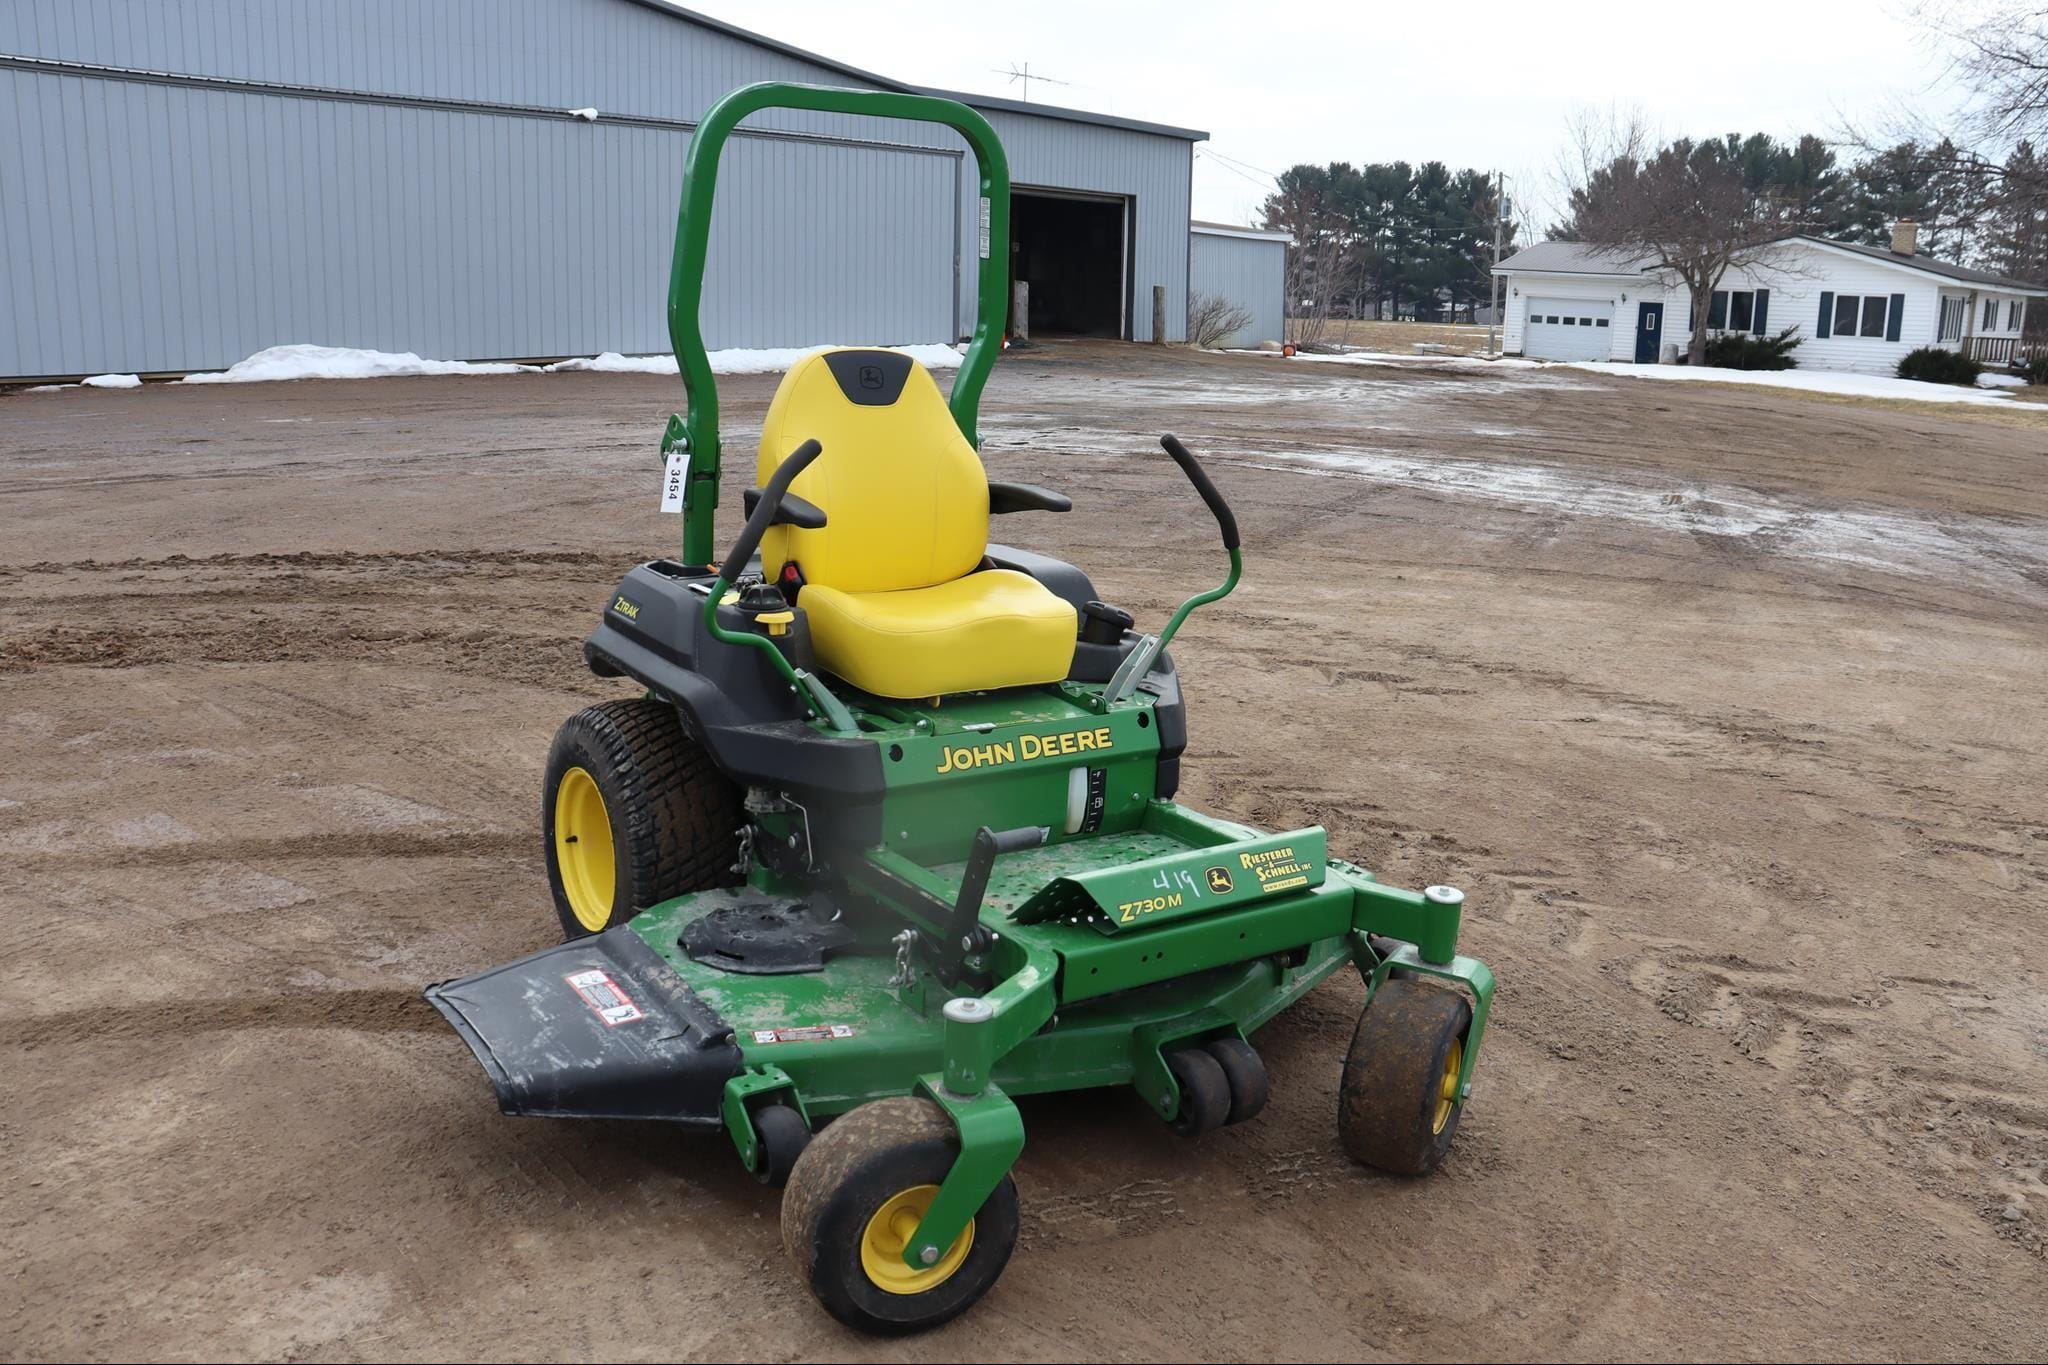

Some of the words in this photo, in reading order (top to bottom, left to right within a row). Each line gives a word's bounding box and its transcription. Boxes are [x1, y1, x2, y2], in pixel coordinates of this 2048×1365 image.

[668, 469, 681, 500] 3454
[613, 596, 640, 619] ZTRAK
[936, 741, 1015, 774] JOHN
[1018, 727, 1113, 761] DEERE
[1239, 847, 1294, 869] RIESTERER
[1255, 863, 1301, 882] SCHNELL
[1301, 862, 1313, 871] INC
